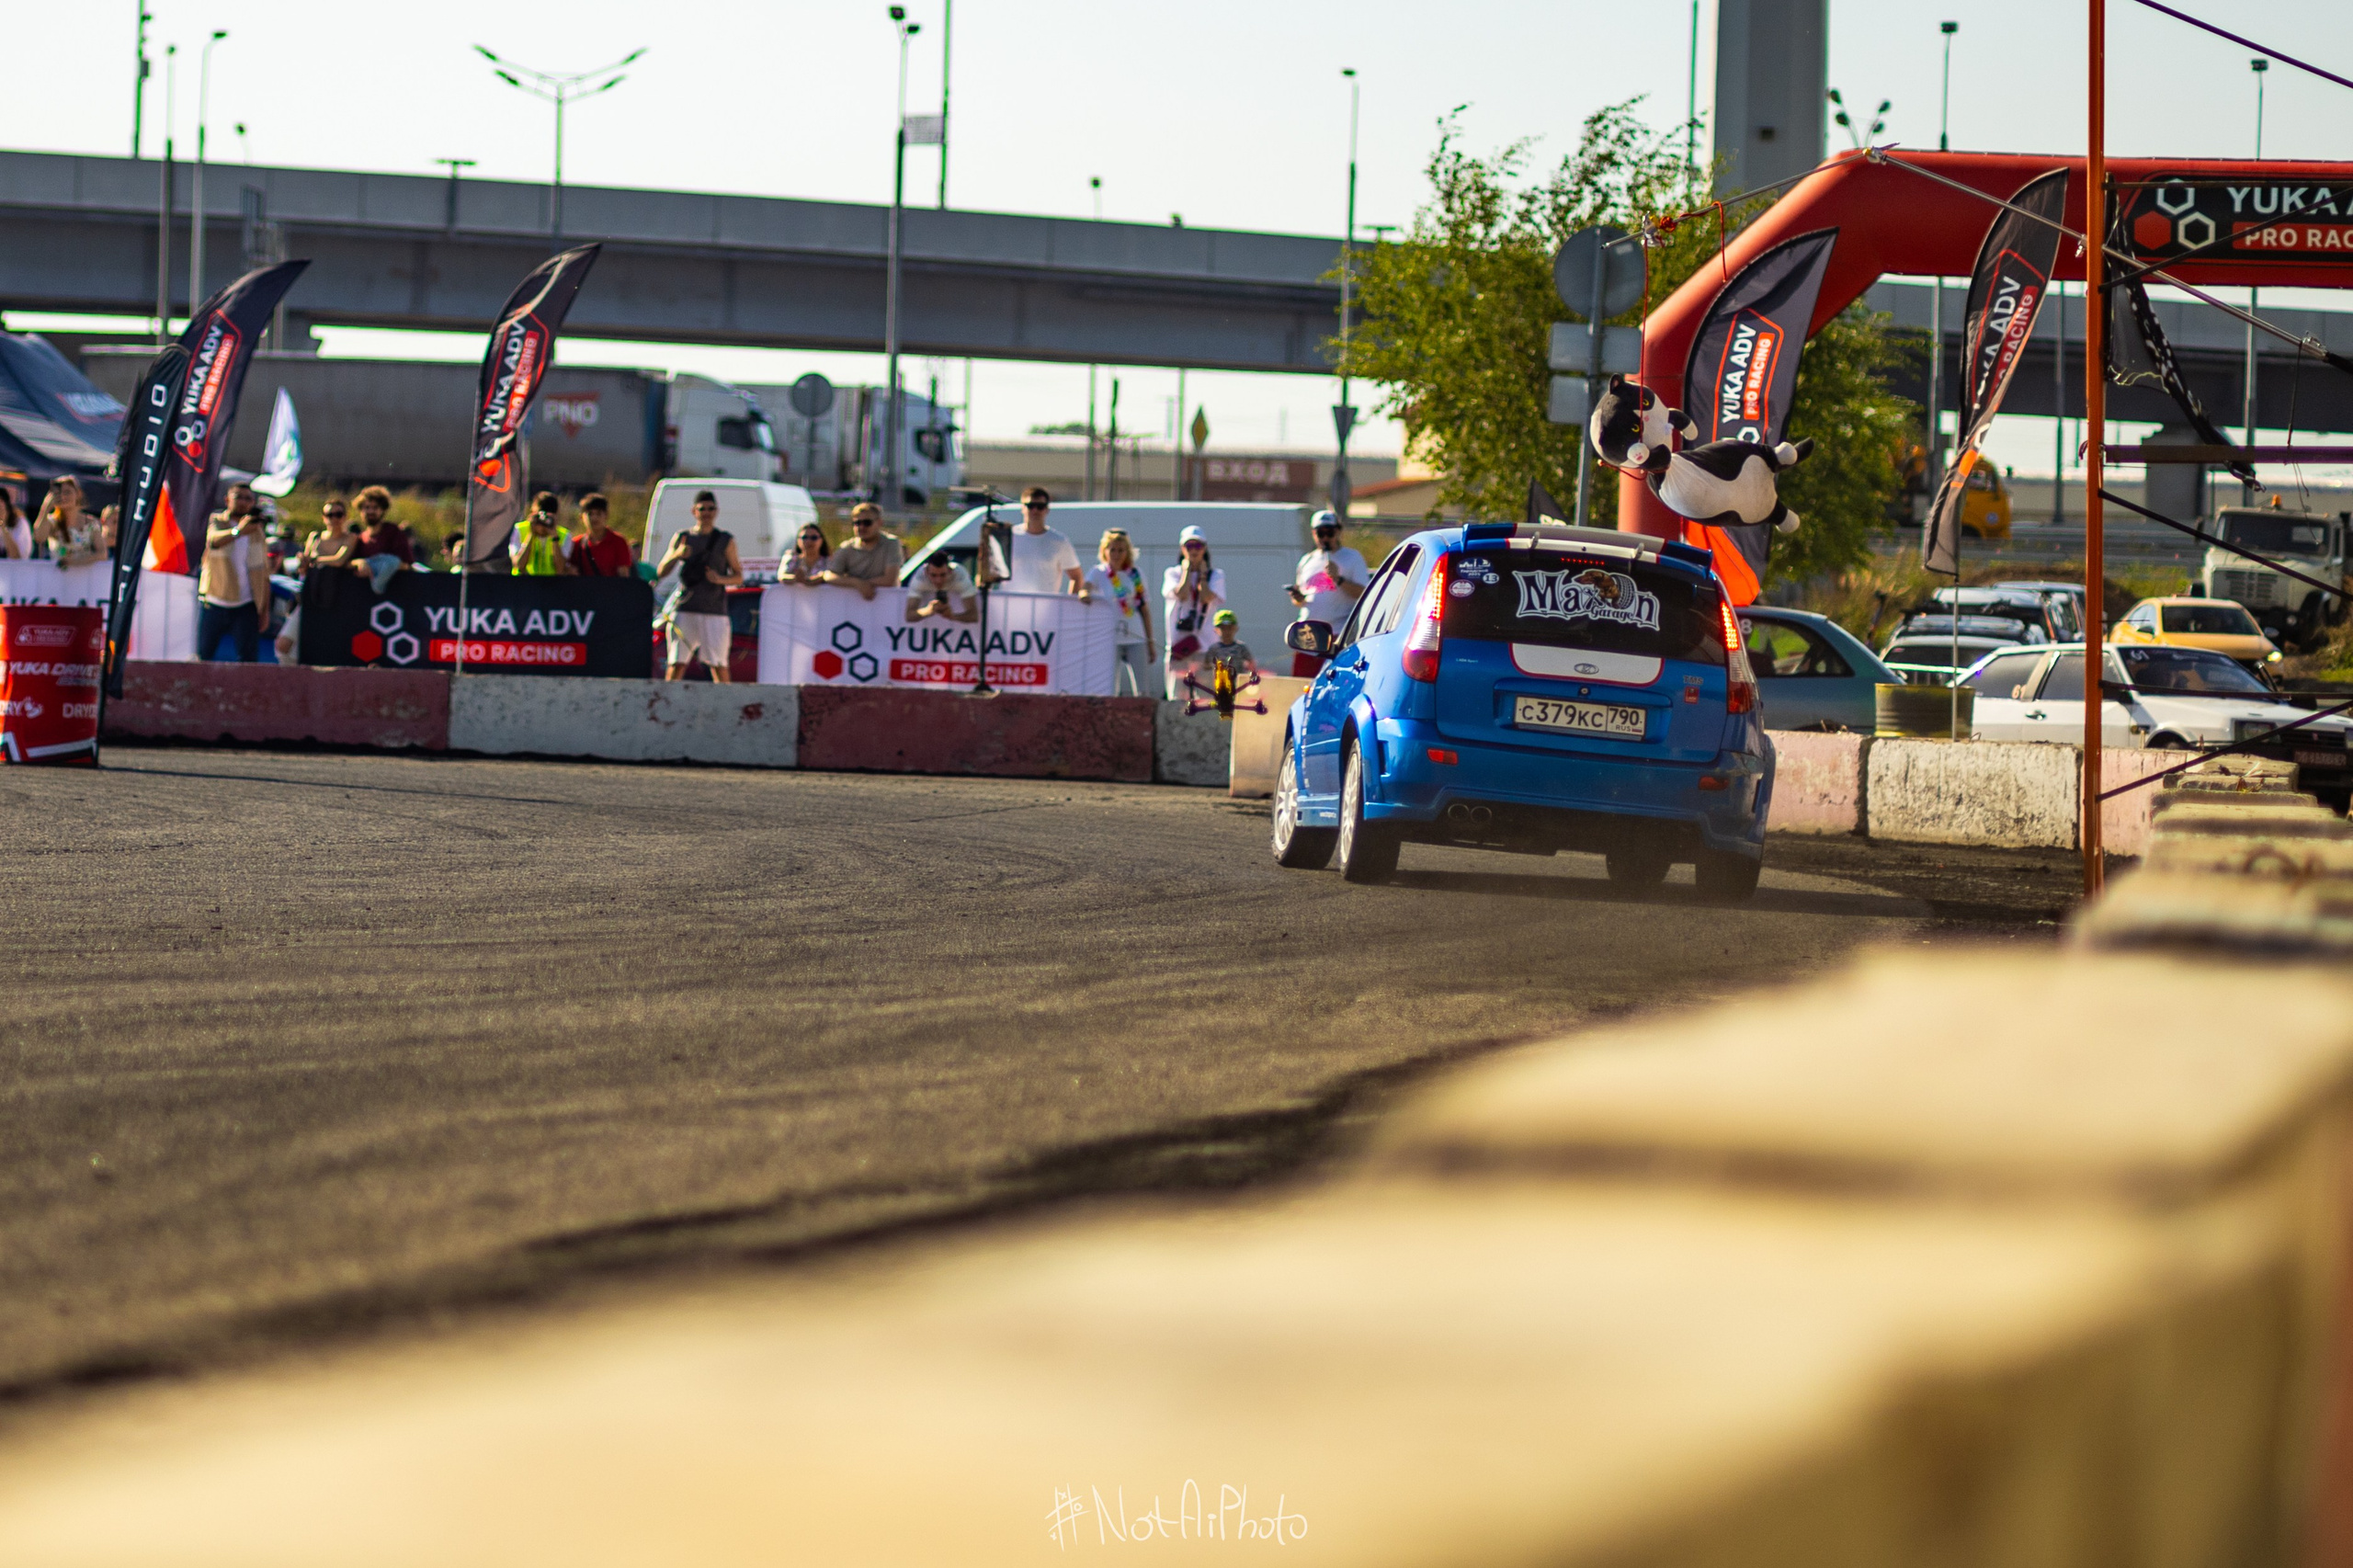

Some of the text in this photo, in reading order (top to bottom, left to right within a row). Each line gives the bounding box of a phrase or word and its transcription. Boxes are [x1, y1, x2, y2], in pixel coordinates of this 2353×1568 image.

[2227, 187, 2339, 216] YUKA
[2245, 228, 2298, 247] PRO
[1990, 275, 2021, 335] ADV
[181, 324, 223, 415] YUKA ADV
[481, 321, 527, 432] YUKA ADV
[1722, 324, 1756, 424] YUKA ADV
[1746, 338, 1772, 415] PRO RACING
[1208, 460, 1290, 485] ВХОД
[424, 607, 595, 636] YUKA ADV
[440, 643, 577, 663] PRO RACING
[885, 626, 1055, 655] YUKA ADV
[10, 662, 50, 676] YUKA
[901, 663, 1037, 683] PRO RACING
[1521, 701, 1640, 728] С379КС 790
[1616, 724, 1631, 733] RUS
